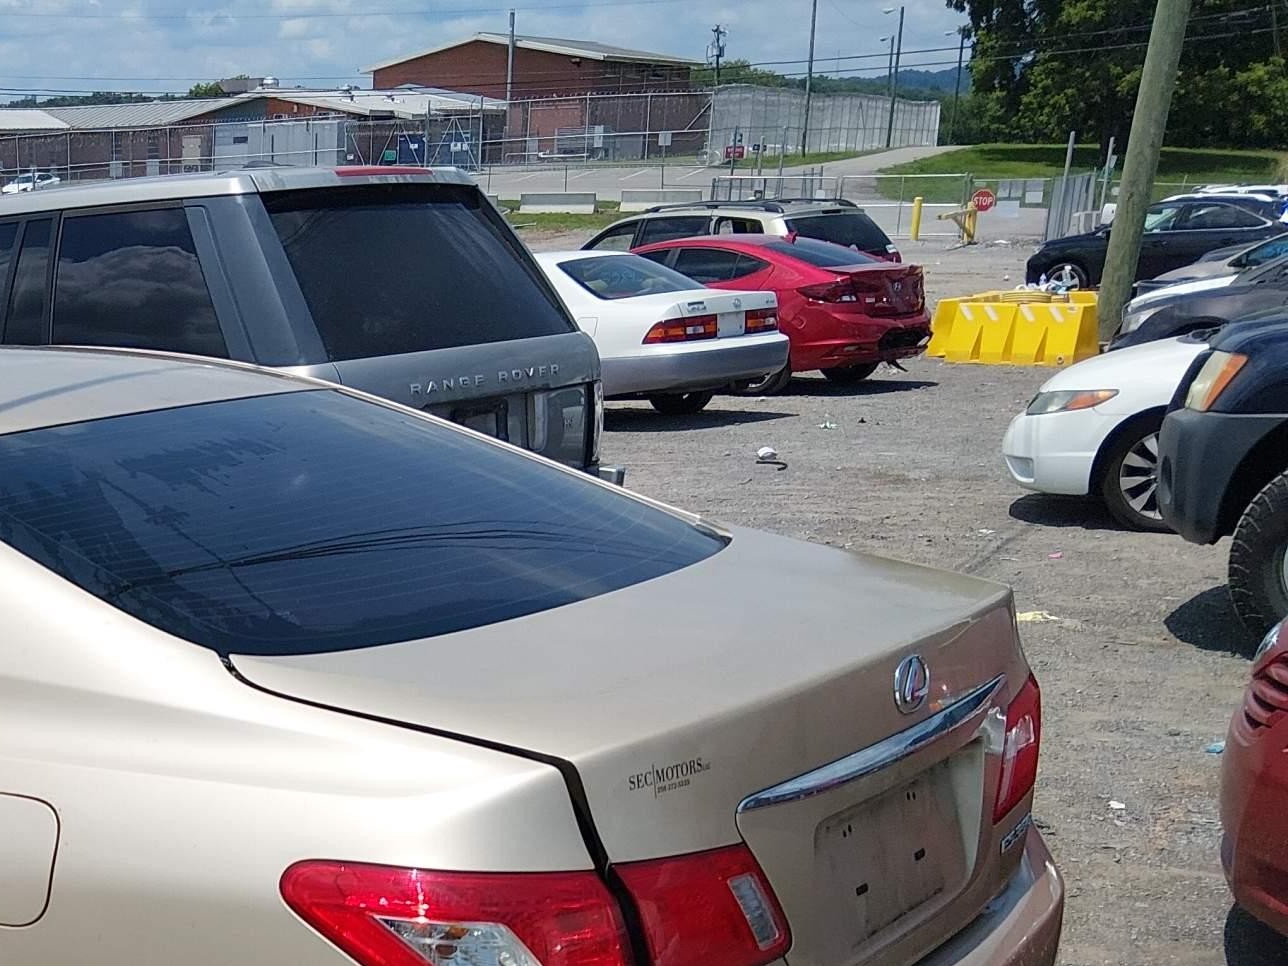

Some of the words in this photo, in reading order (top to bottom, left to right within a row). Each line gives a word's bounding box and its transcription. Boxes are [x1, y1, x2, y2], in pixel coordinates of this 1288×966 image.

[973, 196, 992, 206] STOP
[410, 374, 485, 396] RANGE
[498, 364, 560, 383] ROVER
[628, 771, 653, 791] SEC
[655, 757, 702, 784] MOTORS
